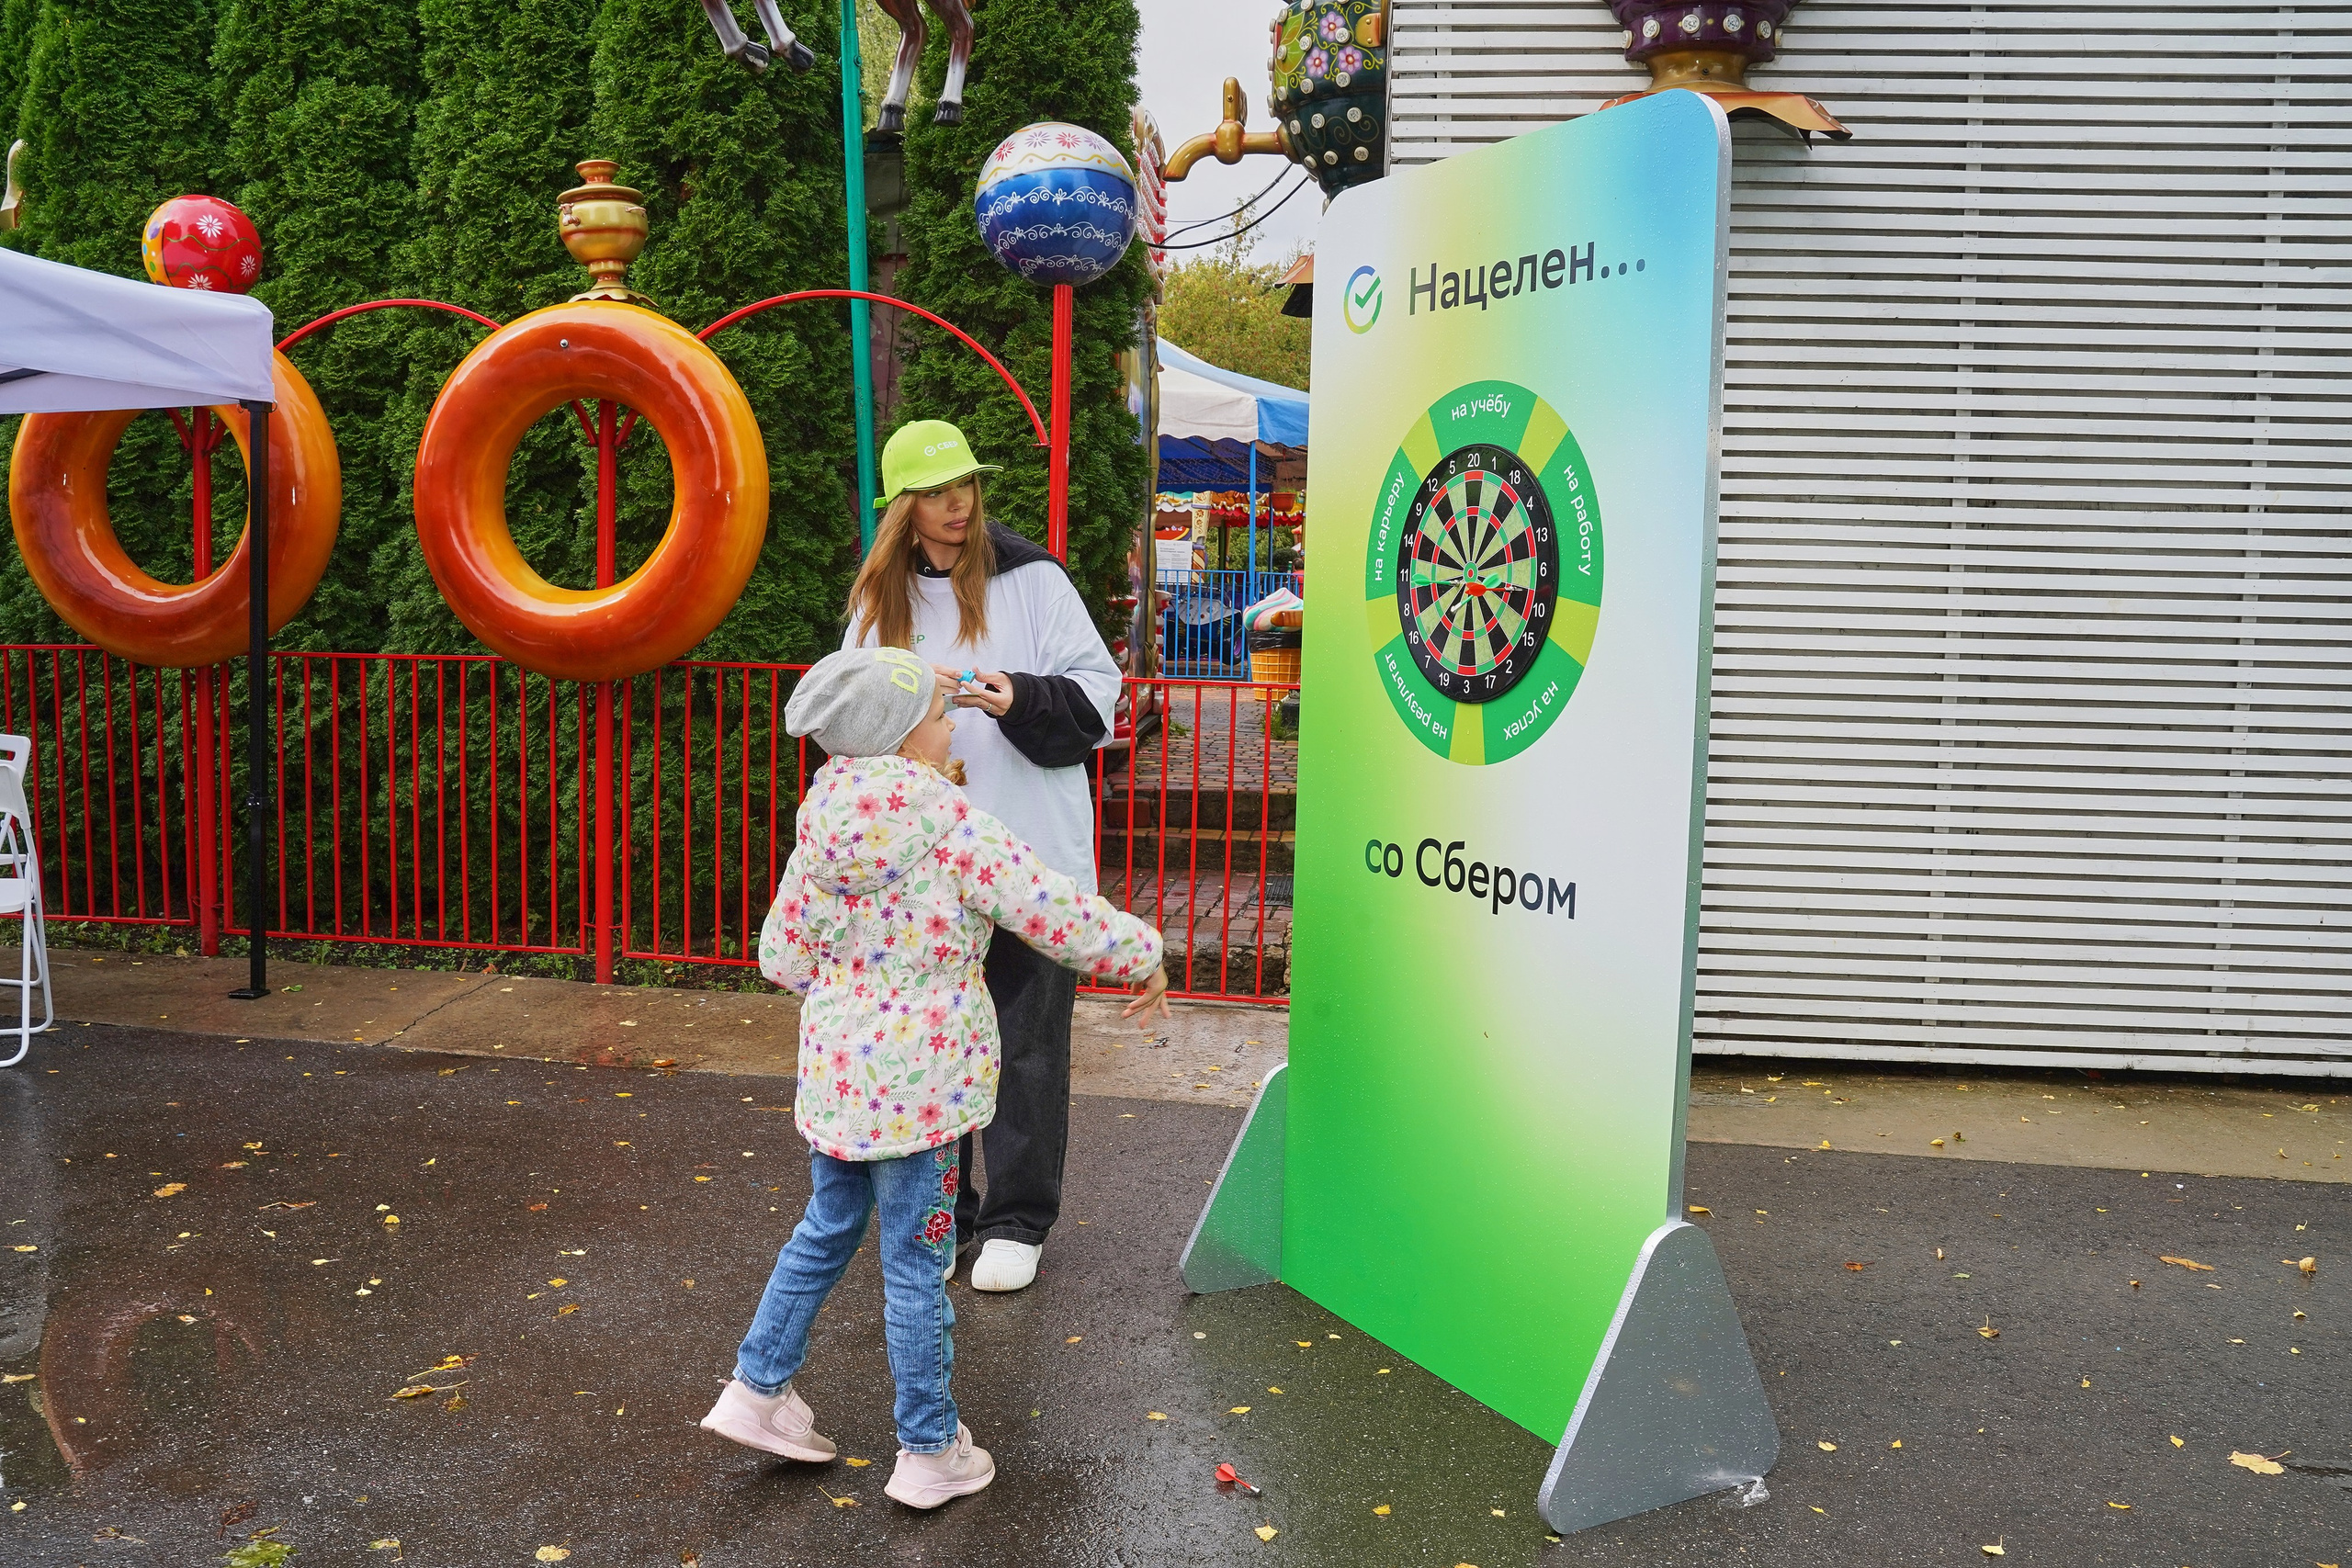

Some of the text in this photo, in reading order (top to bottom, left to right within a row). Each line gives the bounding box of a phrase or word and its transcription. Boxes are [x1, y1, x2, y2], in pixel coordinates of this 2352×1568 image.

[1408, 241, 1645, 316] Нацелен...
[1451, 393, 1511, 421] на учёбу
[1449, 460, 1456, 474] 5
[1467, 453, 1480, 468] 20
[1491, 456, 1497, 470] 1
[1509, 469, 1521, 485] 18
[1427, 478, 1439, 492] 12
[1416, 502, 1422, 516] 9
[1526, 496, 1533, 511] 4
[1374, 471, 1405, 581] на карьеру
[1563, 464, 1594, 576] на работу
[1403, 534, 1414, 547] 14
[1536, 527, 1548, 542] 13
[1399, 568, 1409, 582] 11
[1540, 562, 1547, 577] 6
[1404, 603, 1410, 616] 8
[1532, 603, 1545, 617] 10
[1408, 630, 1419, 645] 16
[1522, 631, 1534, 647] 15
[1424, 655, 1431, 669] 7
[1505, 660, 1513, 673] 2
[875, 647, 922, 694] DR
[1439, 672, 1450, 687] 19
[1463, 680, 1470, 694] 3
[1484, 674, 1497, 689] 17
[1385, 652, 1449, 740] на результат
[1503, 681, 1559, 741] на успех
[1364, 838, 1577, 920] со Сбером
